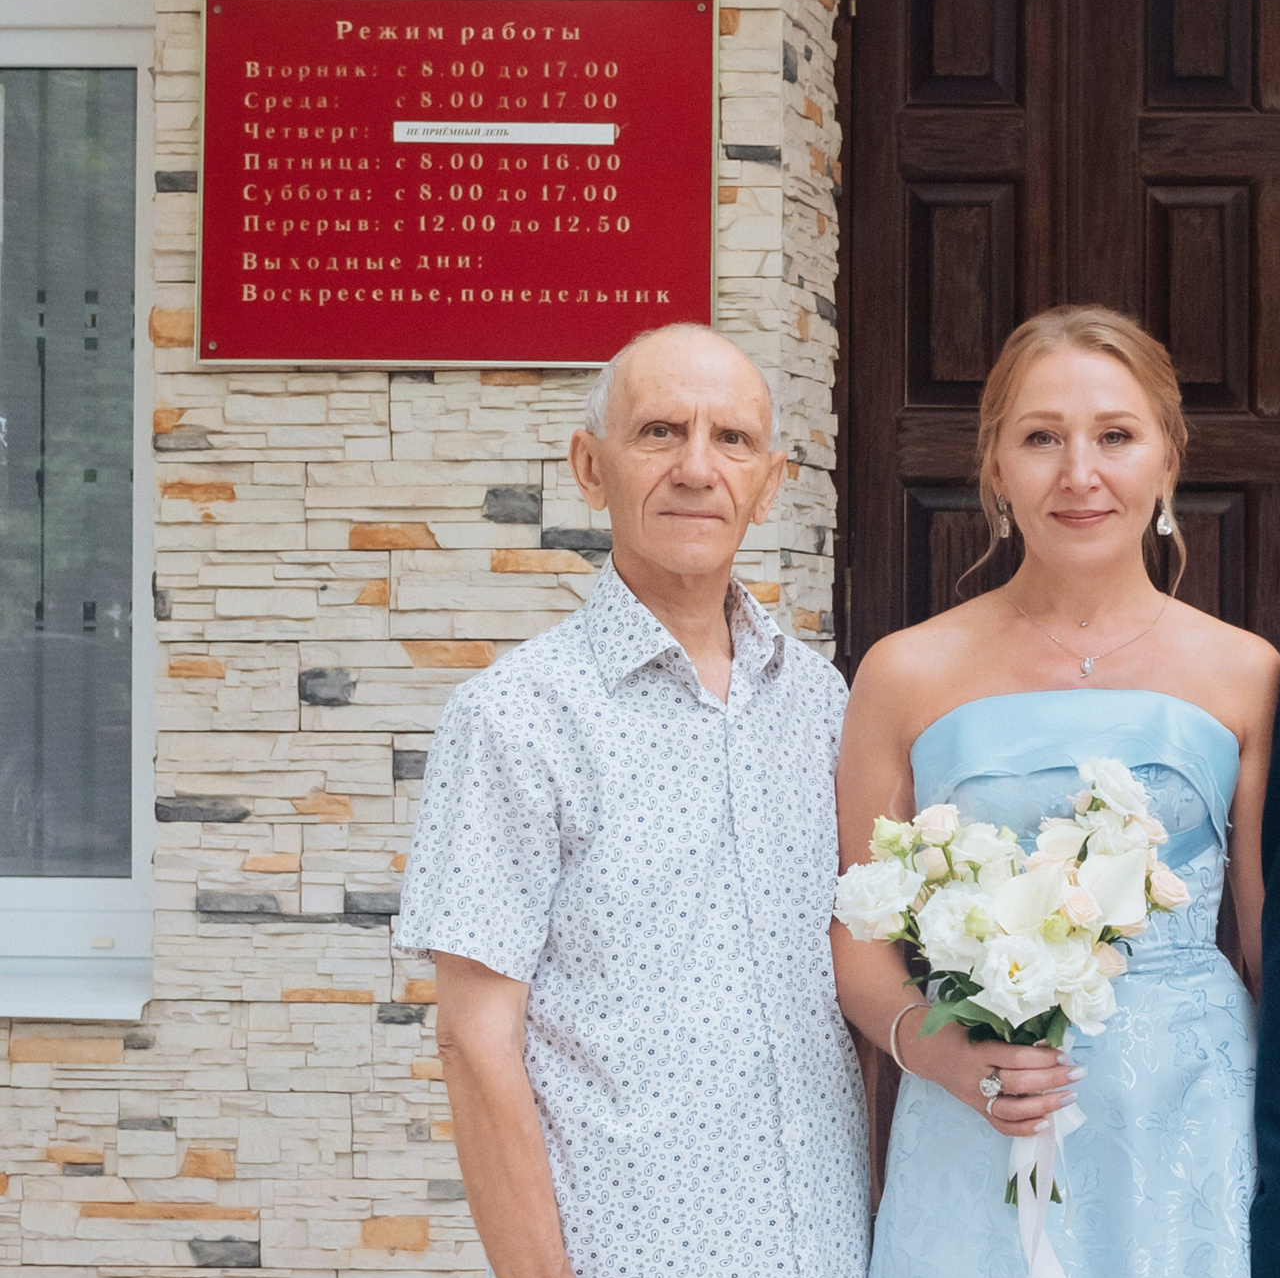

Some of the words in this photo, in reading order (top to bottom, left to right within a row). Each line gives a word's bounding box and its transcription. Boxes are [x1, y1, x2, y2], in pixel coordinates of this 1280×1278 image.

[335, 20, 444, 40] Режим
[460, 21, 580, 46] работы
[244, 60, 377, 82] Вторник:
[396, 65, 407, 78] с
[421, 60, 485, 78] 8.00
[498, 65, 529, 80] до
[543, 60, 619, 79] 17.00
[243, 91, 339, 114] Среда:
[395, 95, 406, 109] с
[420, 91, 484, 109] 8.00
[497, 95, 528, 110] до
[243, 121, 369, 144] Четверг:
[406, 127, 419, 136] НЕ
[482, 127, 510, 138] ДЕНЬ
[243, 152, 380, 171] Пятница:
[394, 157, 406, 170] с
[419, 152, 484, 170] 8.00
[497, 157, 528, 172] до
[542, 153, 621, 171] 16.00
[242, 183, 372, 206] Суббота:
[394, 188, 406, 201] с
[418, 183, 483, 201] 8.00
[496, 188, 527, 202] до
[541, 184, 618, 202] 17.00
[243, 214, 380, 237] Перерыв:
[393, 219, 405, 232] с
[419, 214, 496, 232] 12.00
[509, 219, 540, 234] до
[554, 215, 631, 234] 12.50
[242, 251, 402, 272] Выходные
[416, 254, 483, 270] дни:
